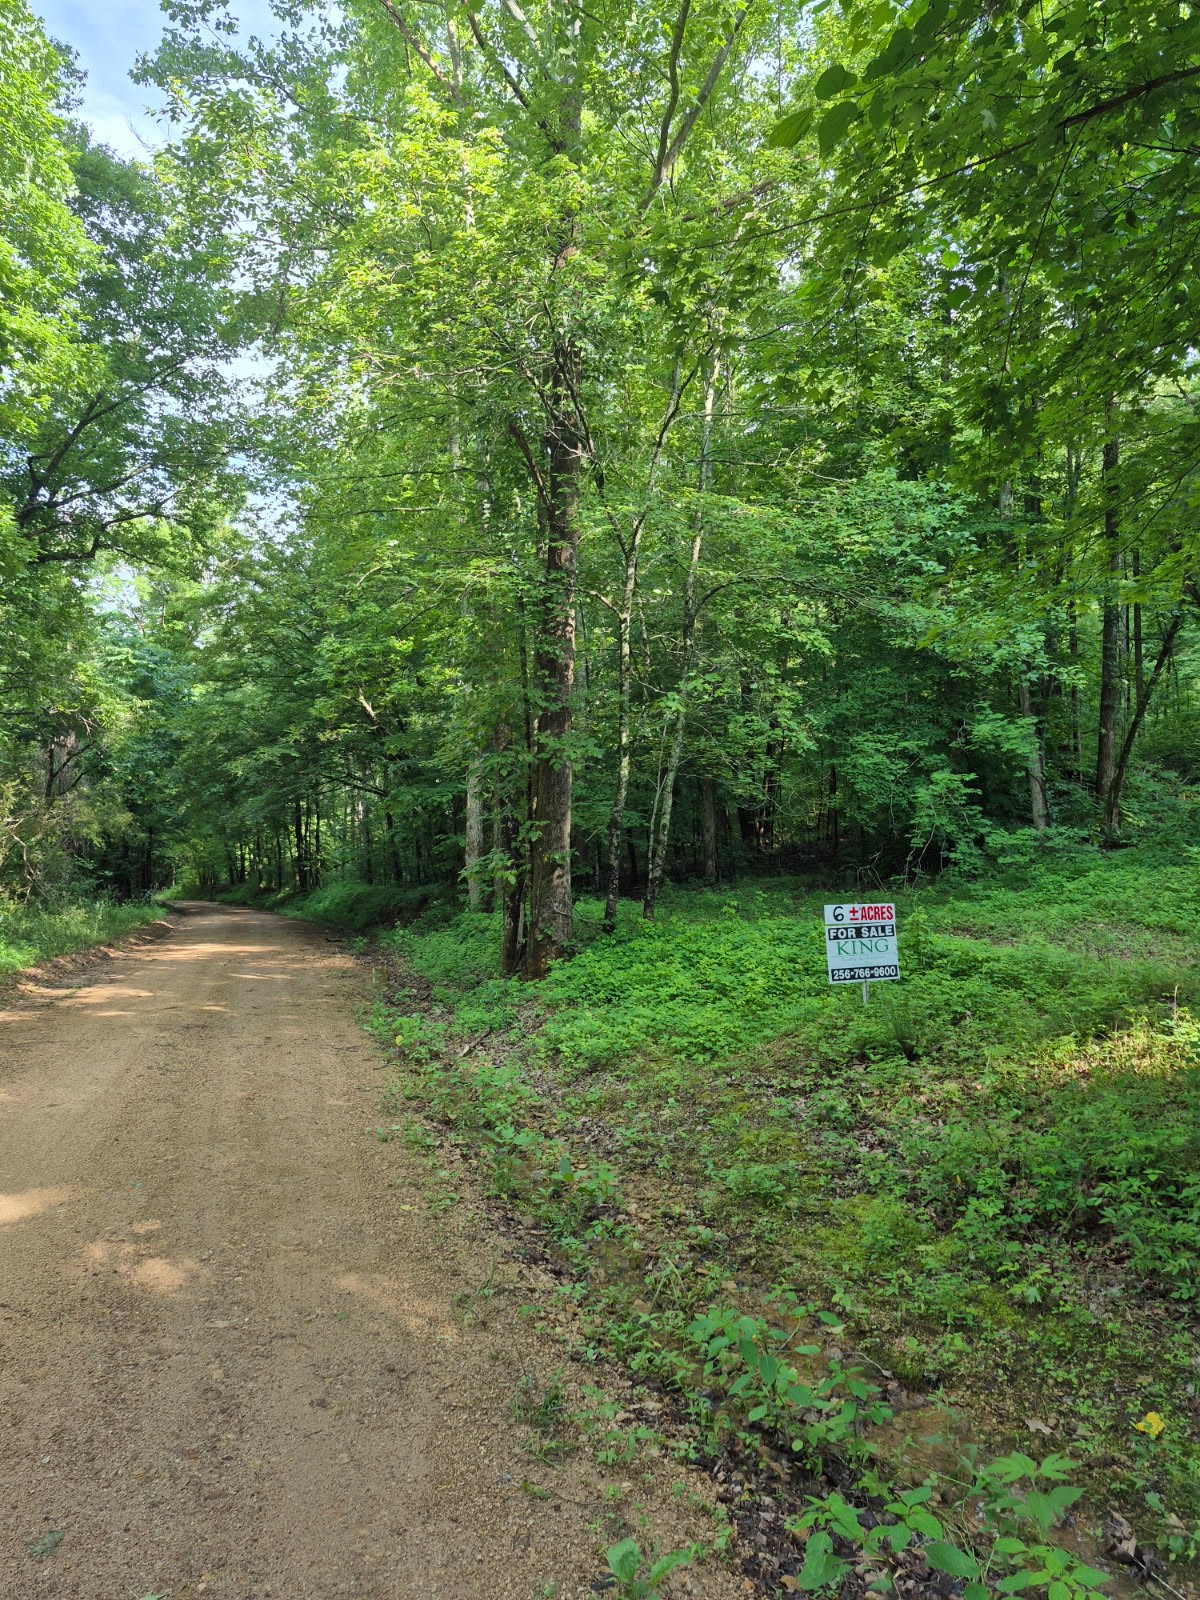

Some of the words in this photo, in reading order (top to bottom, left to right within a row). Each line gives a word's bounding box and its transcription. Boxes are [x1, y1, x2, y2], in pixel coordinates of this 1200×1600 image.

[833, 906, 844, 921] 6
[861, 906, 893, 920] ACRES
[829, 928, 856, 939] FOR
[861, 926, 893, 937] SALE
[836, 938, 889, 955] KING
[833, 966, 896, 980] 256-766-9600
